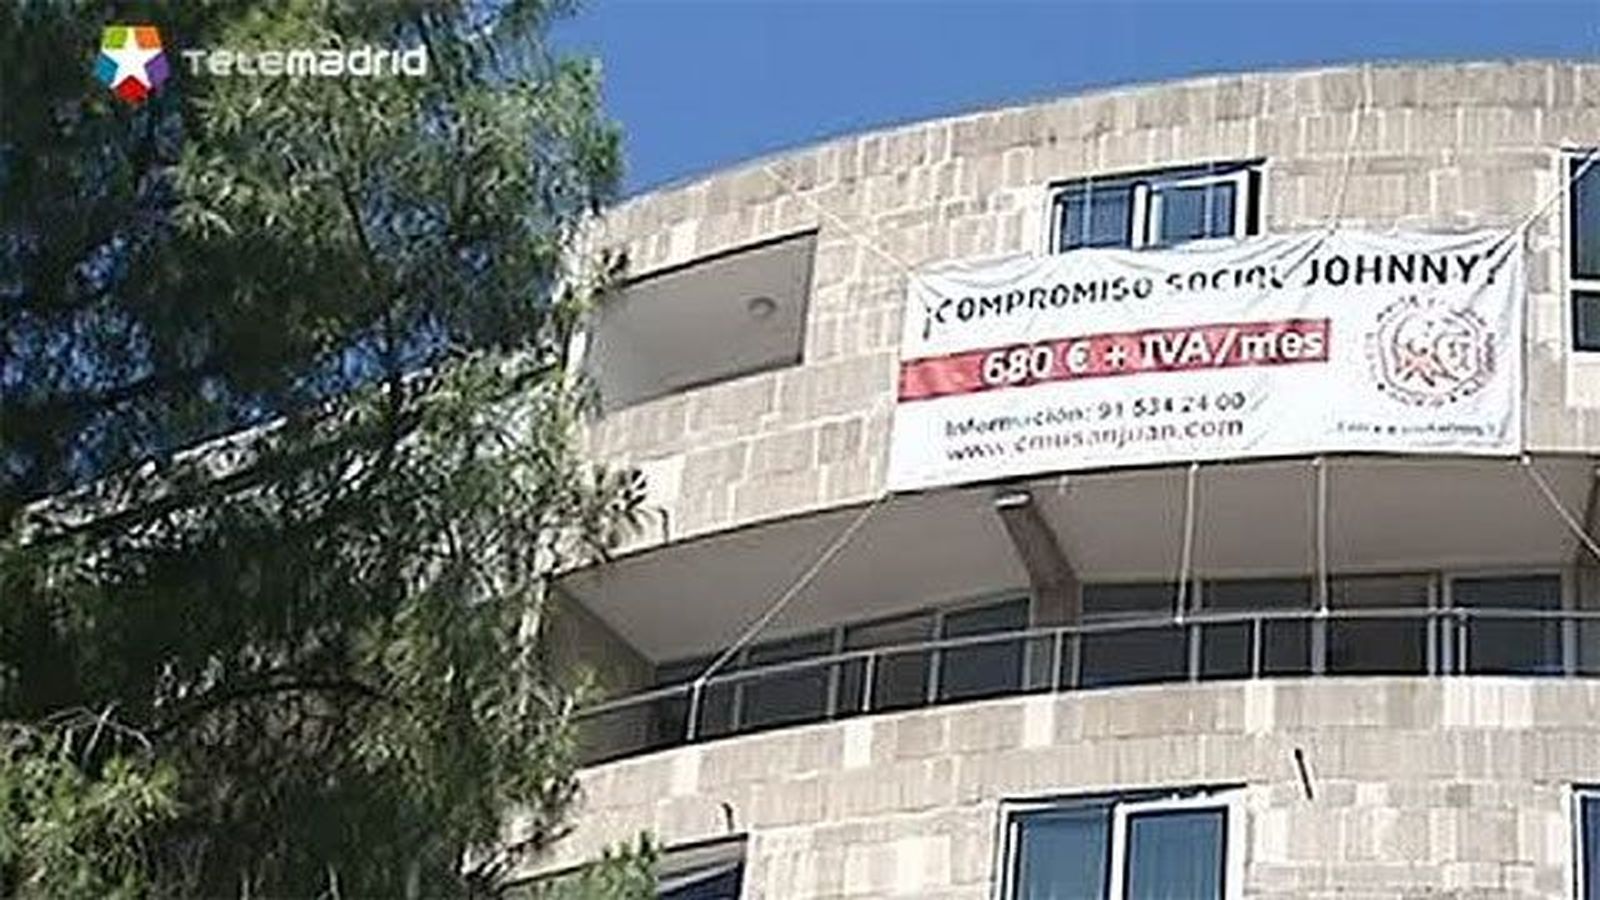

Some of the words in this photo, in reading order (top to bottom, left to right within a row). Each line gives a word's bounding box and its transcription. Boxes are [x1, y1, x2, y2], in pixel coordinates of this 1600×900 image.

[981, 345, 1053, 385] 680
[1065, 341, 1092, 373] €
[1105, 347, 1126, 368] +
[1141, 329, 1326, 367] IVA/mes
